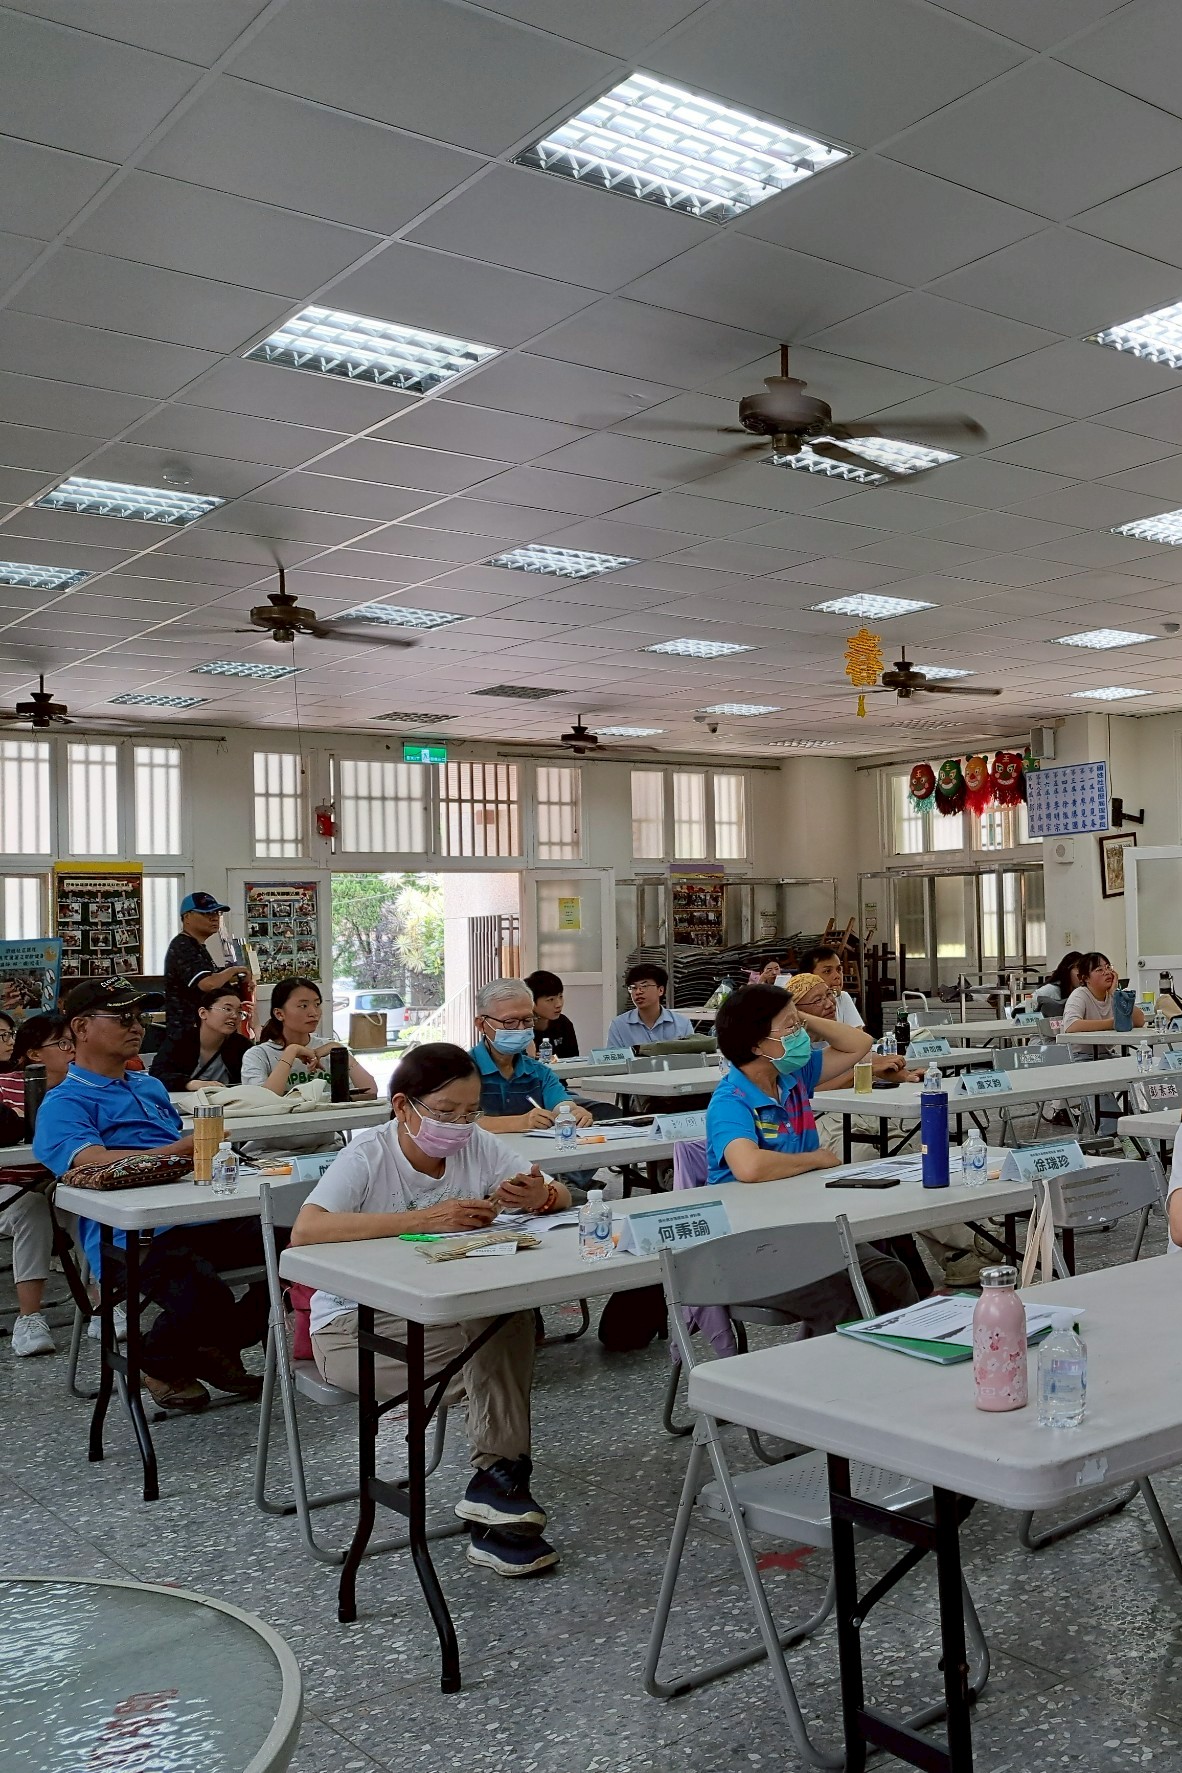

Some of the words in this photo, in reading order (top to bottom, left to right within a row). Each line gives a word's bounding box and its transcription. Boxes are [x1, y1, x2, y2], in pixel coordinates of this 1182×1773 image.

[1033, 1154, 1070, 1173] 徐瑞珍
[658, 1219, 711, 1243] 何秉諭
